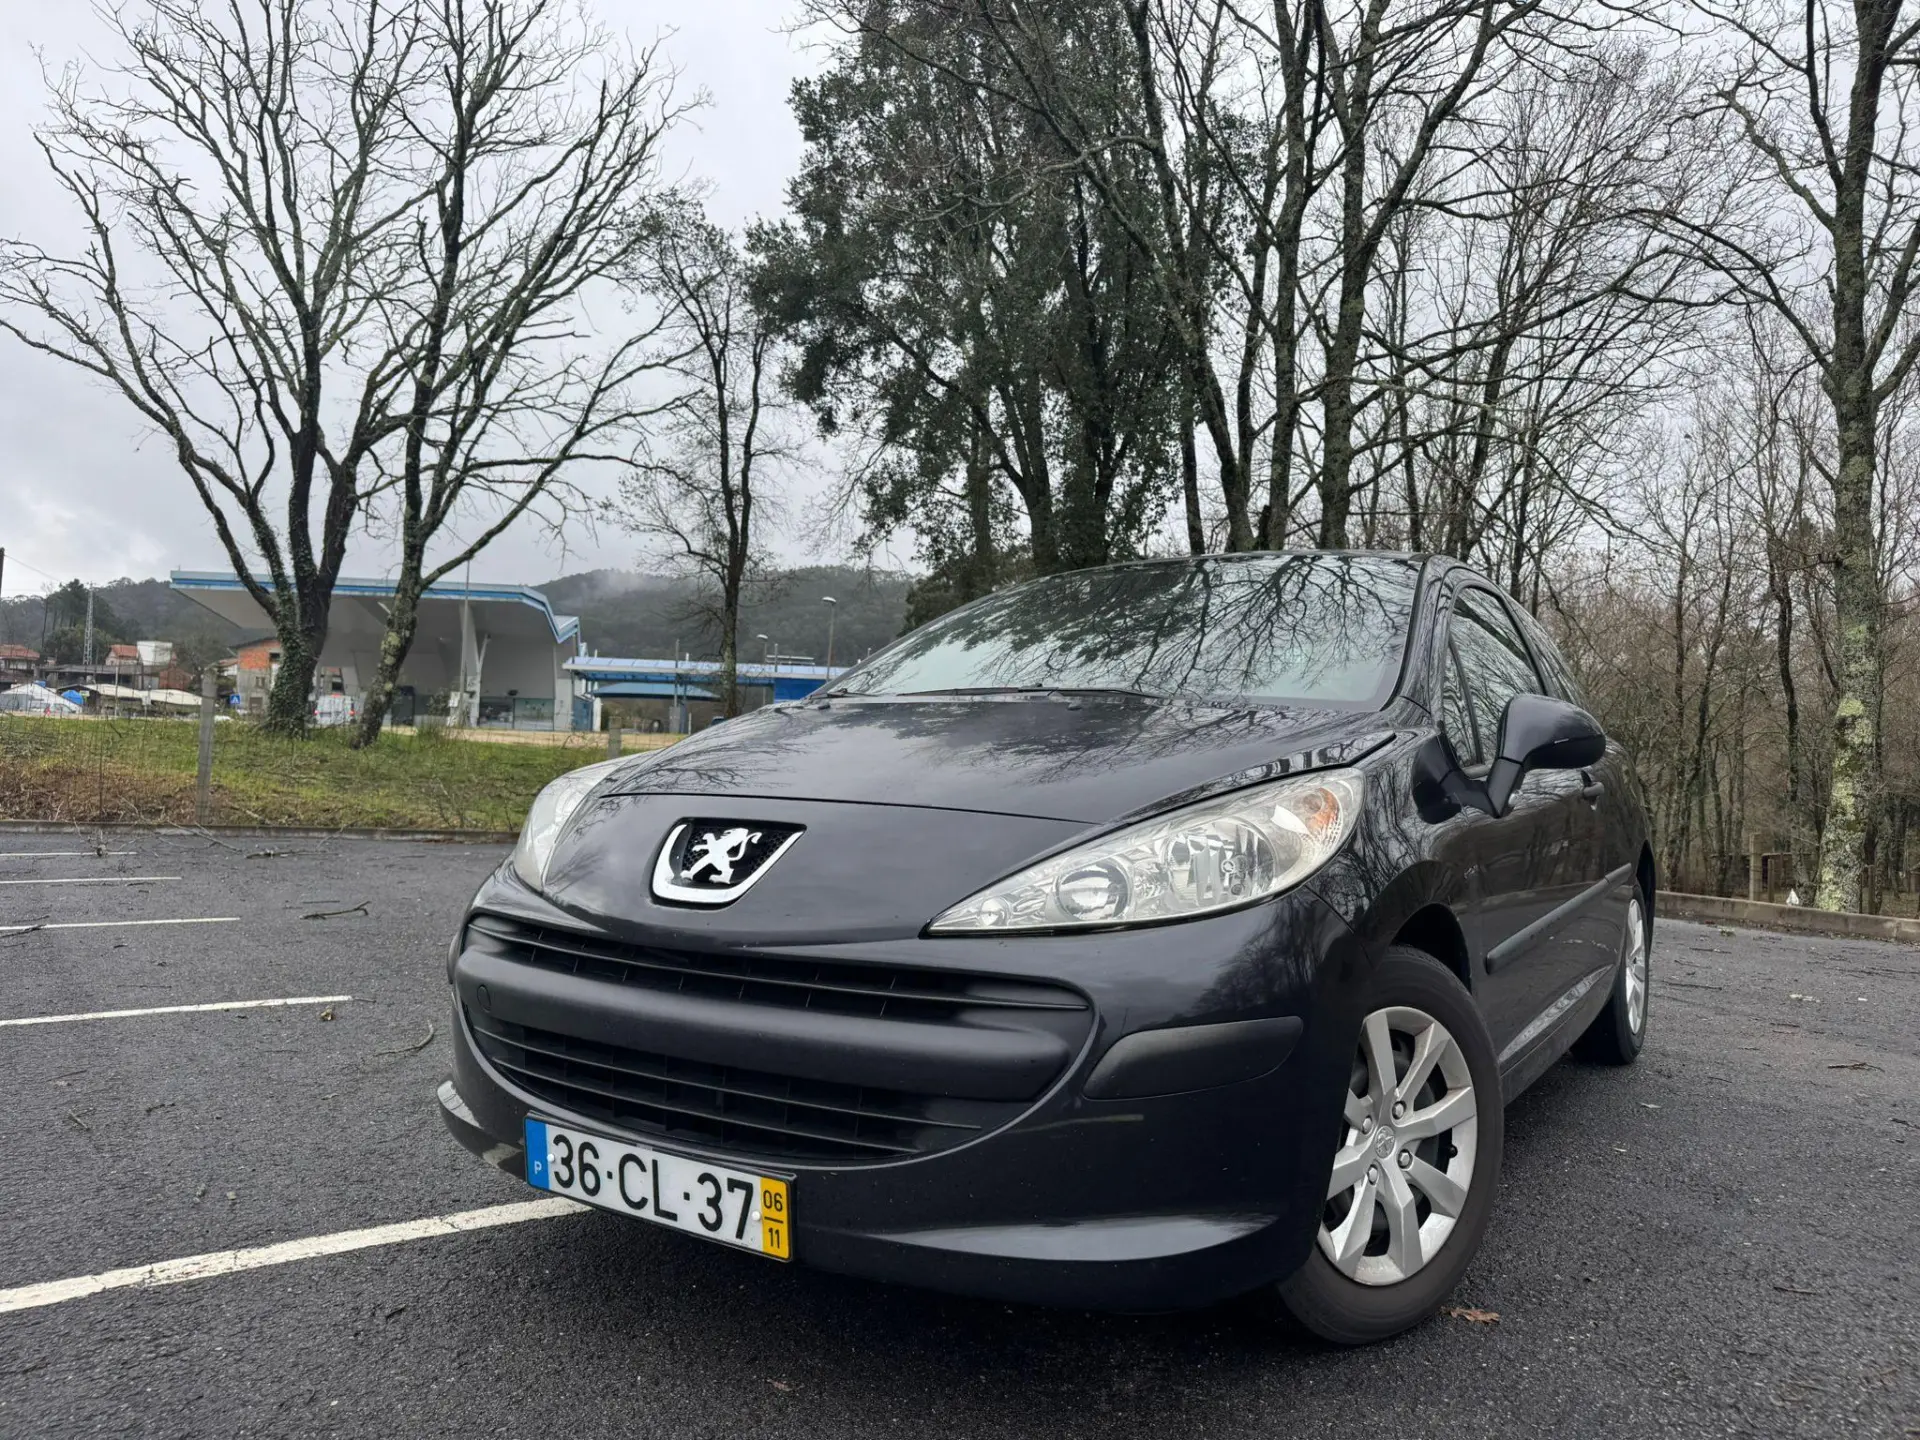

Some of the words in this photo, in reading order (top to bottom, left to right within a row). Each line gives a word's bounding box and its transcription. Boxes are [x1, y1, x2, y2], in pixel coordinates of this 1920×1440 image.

[534, 1160, 542, 1175] P
[762, 1189, 784, 1213] 06
[767, 1227, 781, 1250] 11
